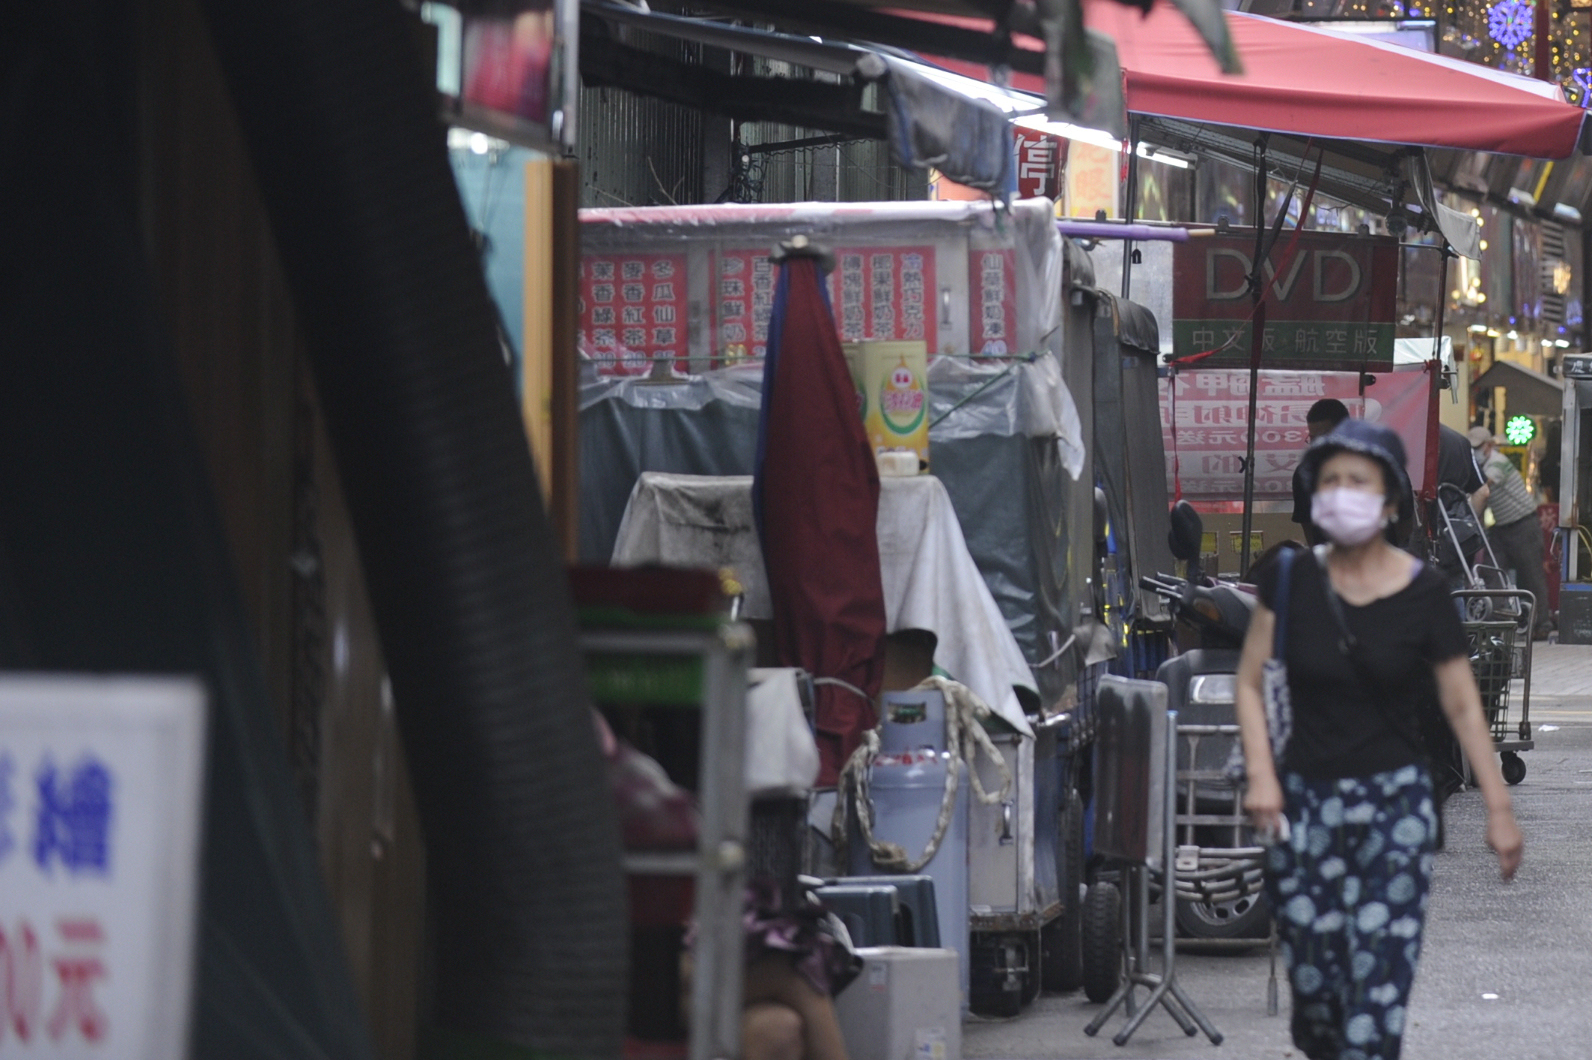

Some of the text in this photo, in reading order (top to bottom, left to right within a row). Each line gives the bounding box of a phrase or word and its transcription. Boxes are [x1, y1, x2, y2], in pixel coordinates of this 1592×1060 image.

[1013, 133, 1058, 196] 停
[652, 259, 676, 345] 冬瓜仙草
[1206, 247, 1362, 302] DVD
